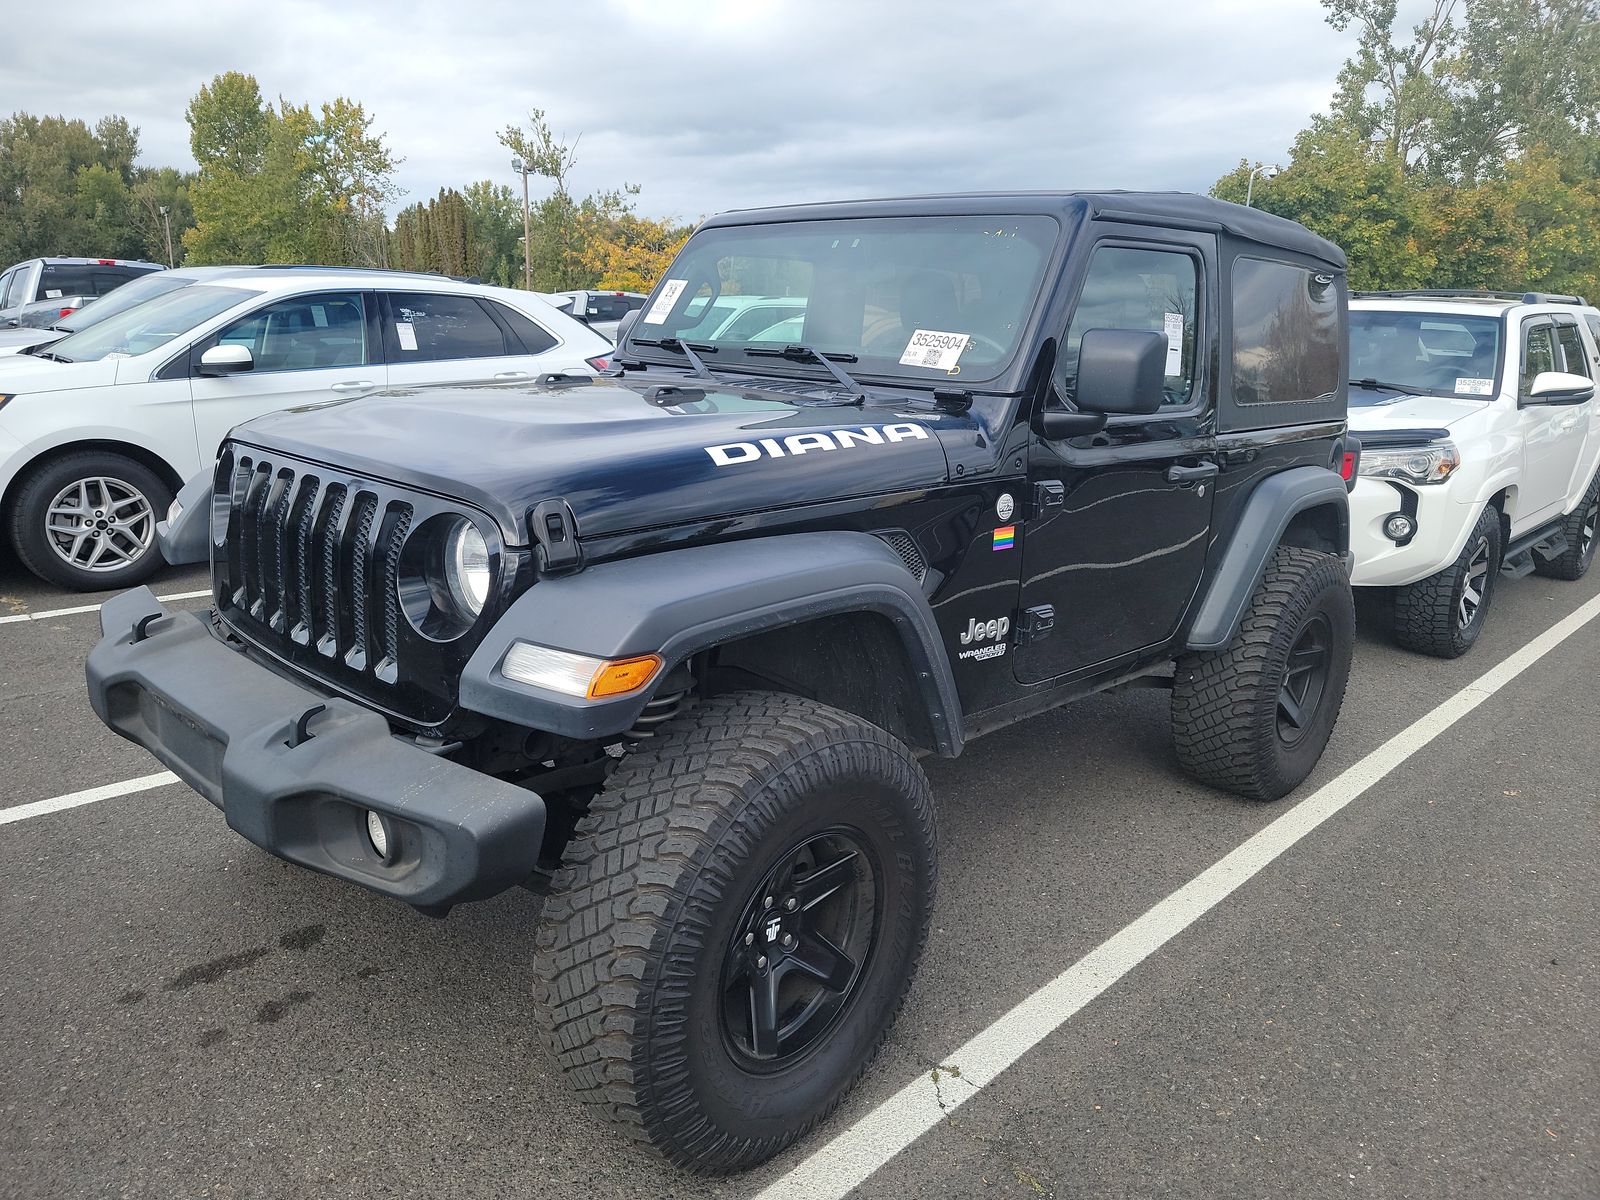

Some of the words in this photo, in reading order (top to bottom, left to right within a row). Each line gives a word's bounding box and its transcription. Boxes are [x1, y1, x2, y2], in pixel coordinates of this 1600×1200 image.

[912, 333, 964, 350] 3525904
[1457, 379, 1491, 387] 3525994
[703, 422, 930, 467] DIANA
[960, 616, 1010, 645] Jeep
[959, 643, 1006, 659] WRANGLER
